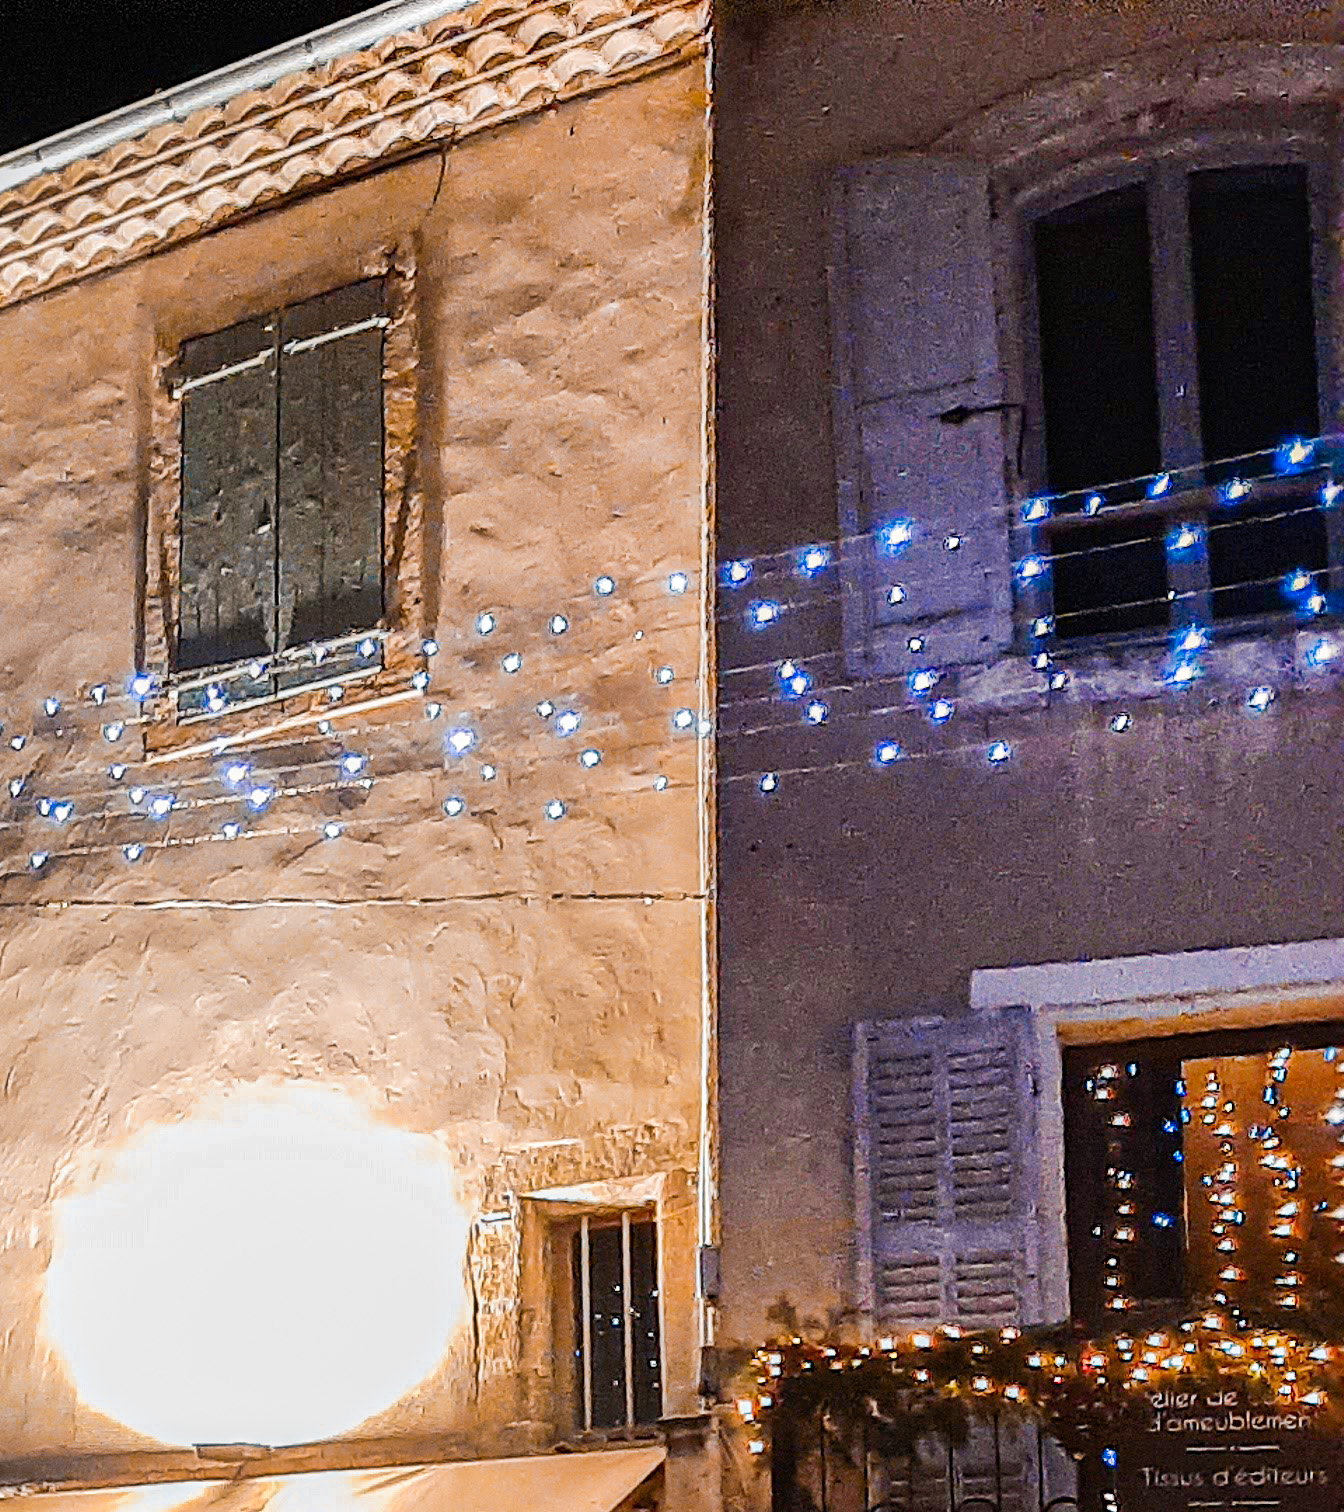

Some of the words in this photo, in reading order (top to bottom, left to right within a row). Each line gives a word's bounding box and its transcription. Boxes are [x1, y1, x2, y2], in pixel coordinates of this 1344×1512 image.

[1207, 1388, 1239, 1407] de
[1147, 1408, 1312, 1433] d'ameublemen
[1139, 1466, 1204, 1486] Tissus
